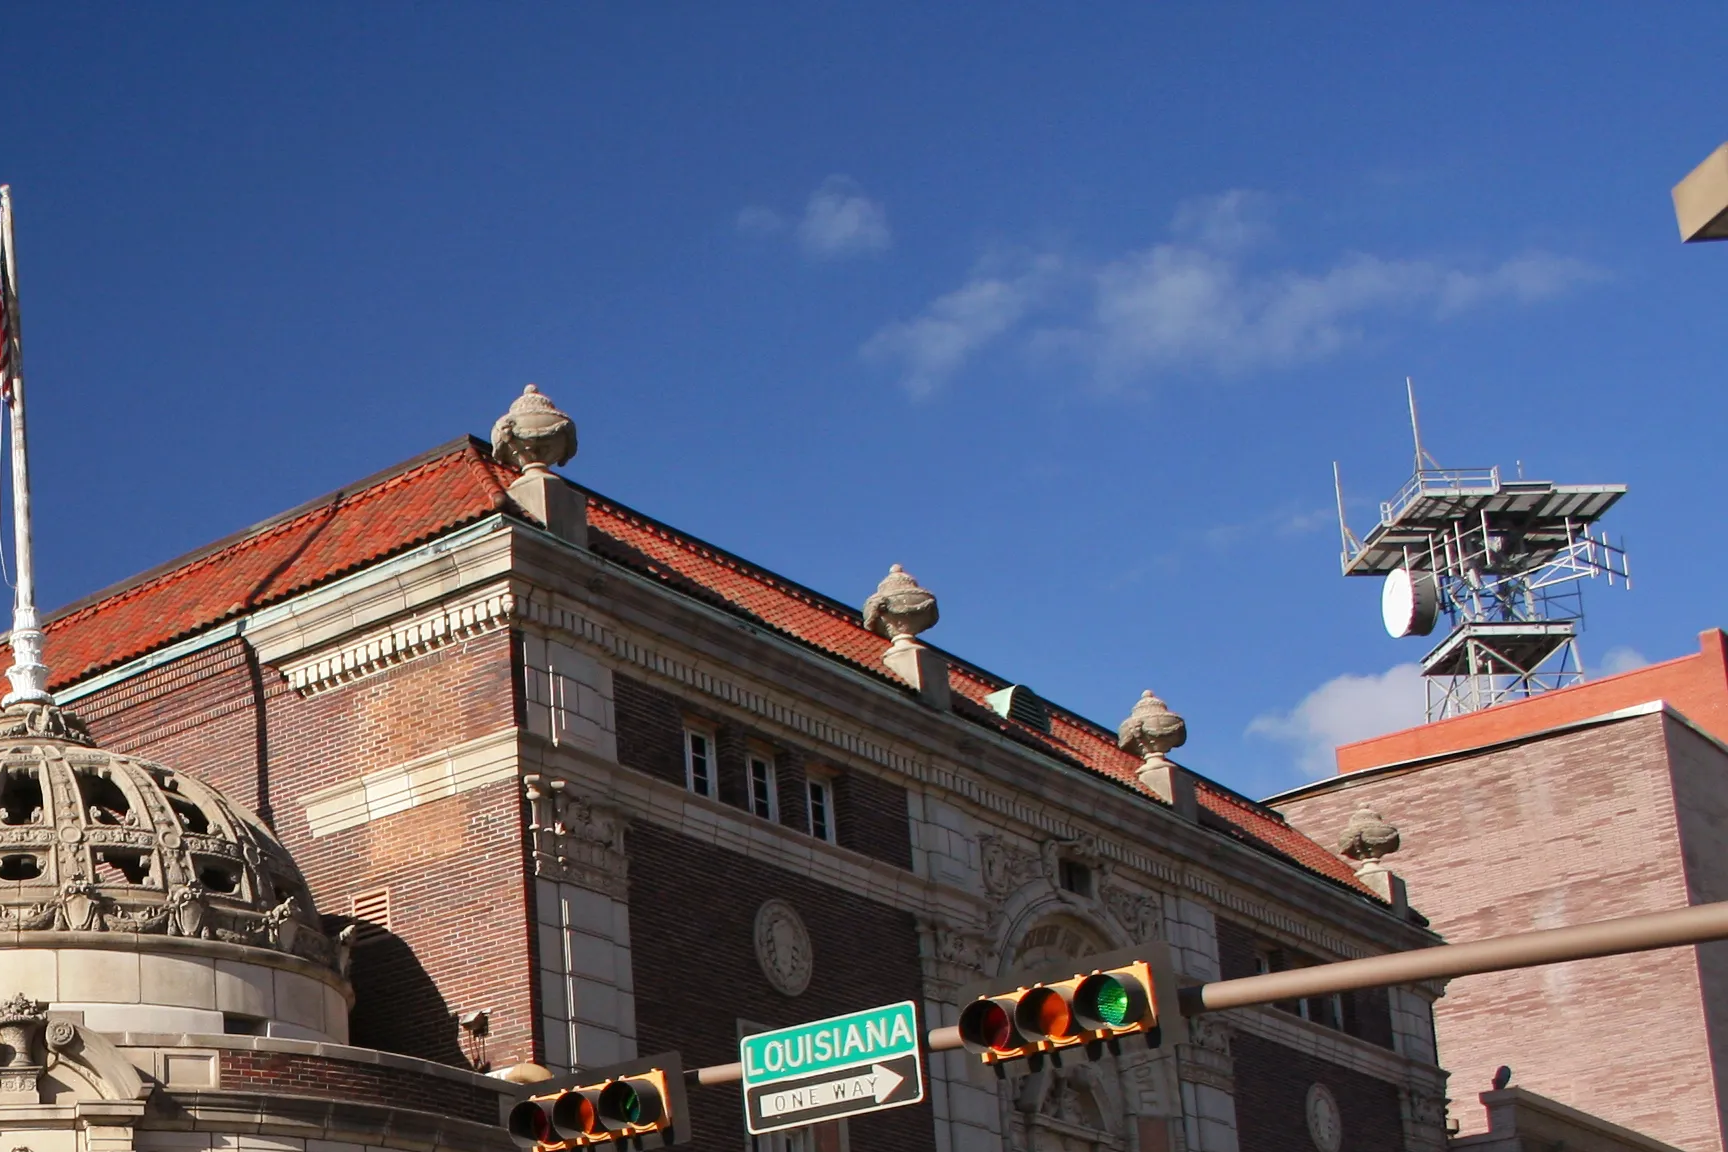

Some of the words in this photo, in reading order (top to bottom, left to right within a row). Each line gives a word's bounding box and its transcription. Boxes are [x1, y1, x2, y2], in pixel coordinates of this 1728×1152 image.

[746, 1013, 912, 1076] LOUISIANA
[775, 1088, 819, 1112] ONE
[833, 1076, 879, 1099] WAY
